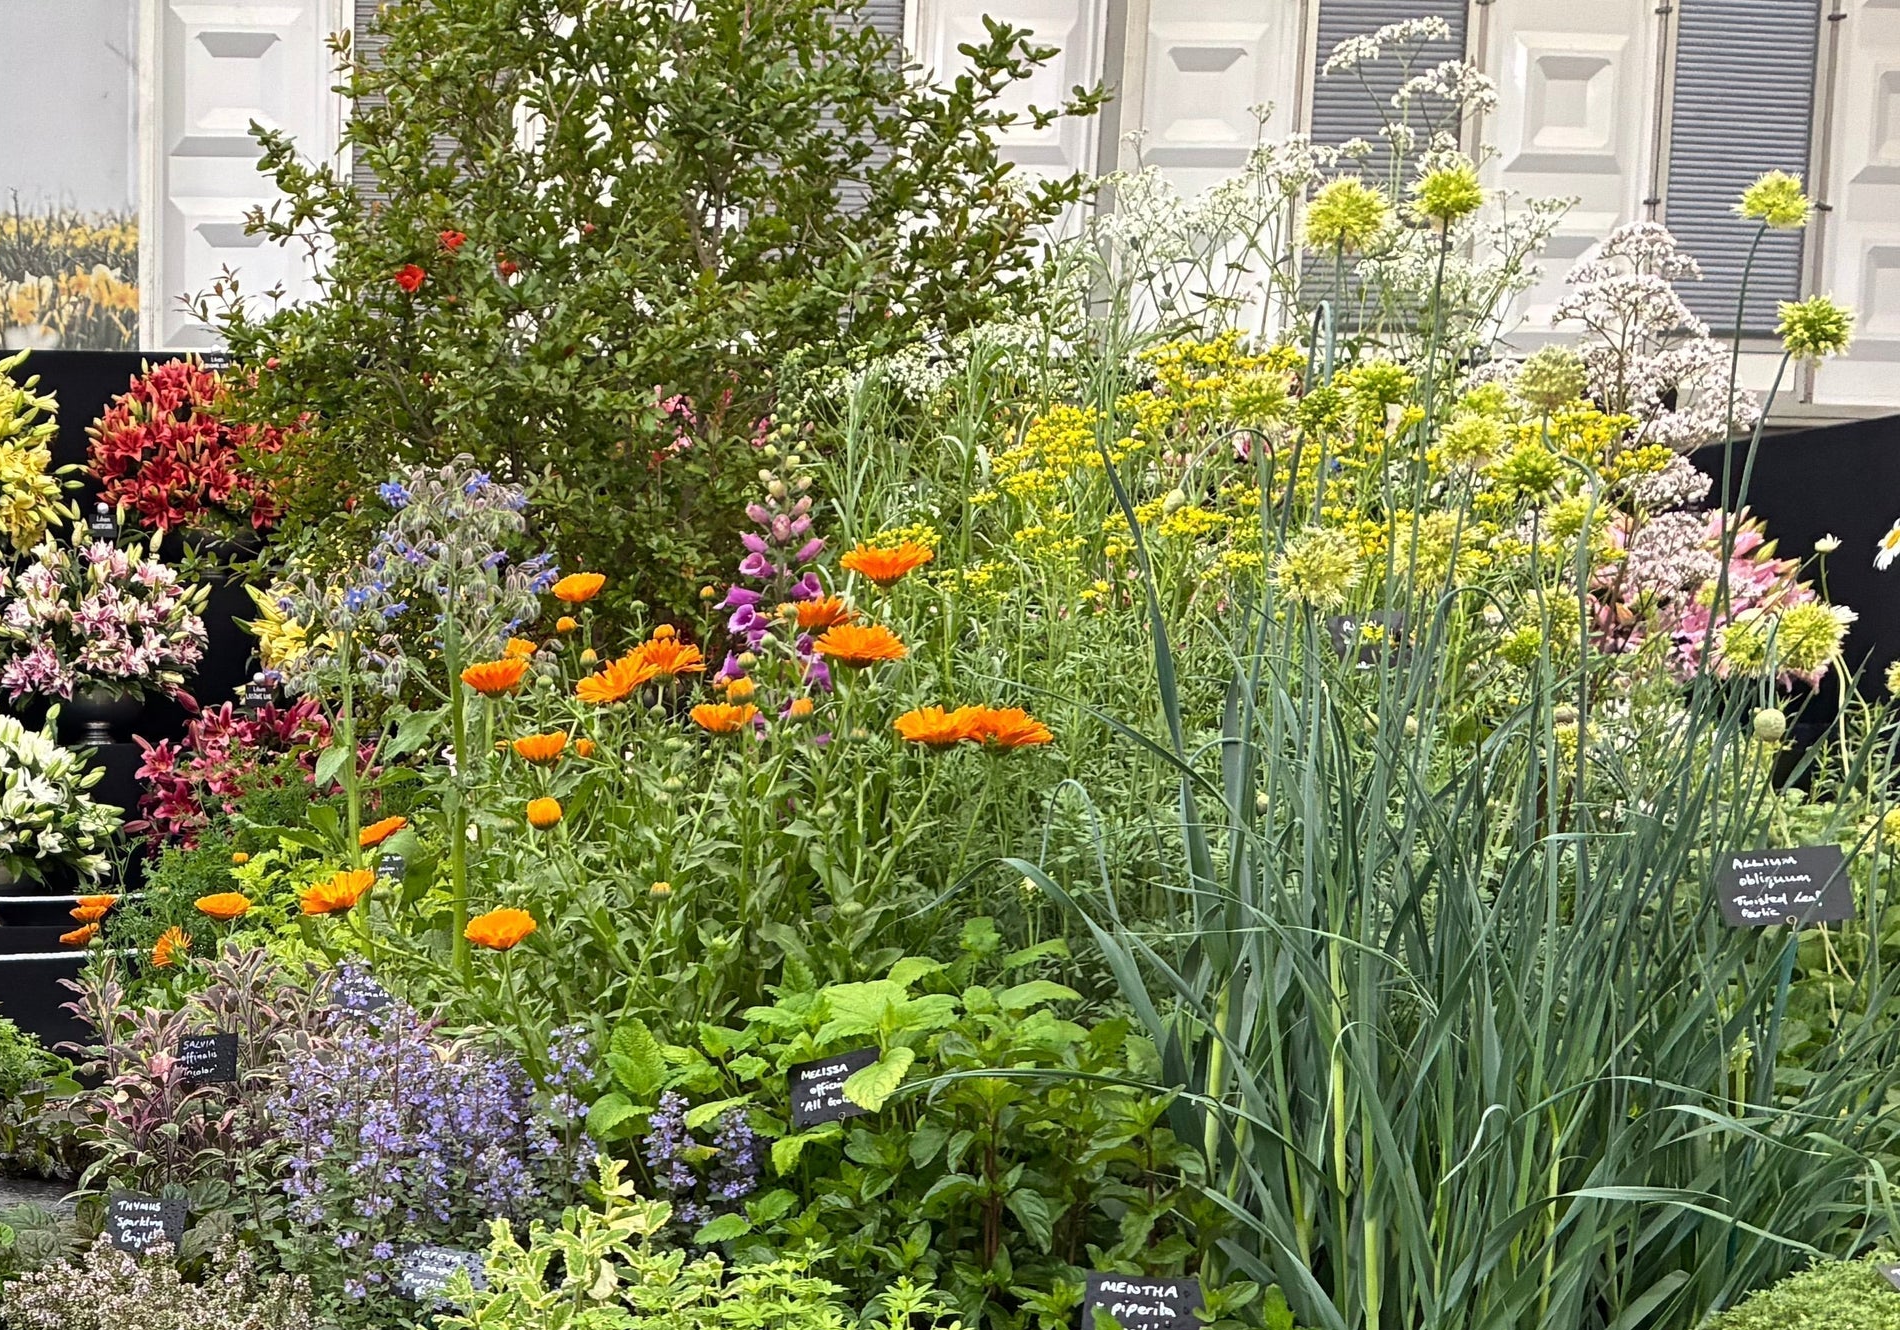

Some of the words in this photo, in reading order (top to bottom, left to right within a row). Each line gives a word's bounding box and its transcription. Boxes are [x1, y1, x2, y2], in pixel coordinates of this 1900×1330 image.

[182, 1039, 216, 1051] SALVIA
[801, 1063, 849, 1081] MELISSA
[117, 1200, 162, 1212] THYMUS
[1100, 1280, 1179, 1299] MENTHA
